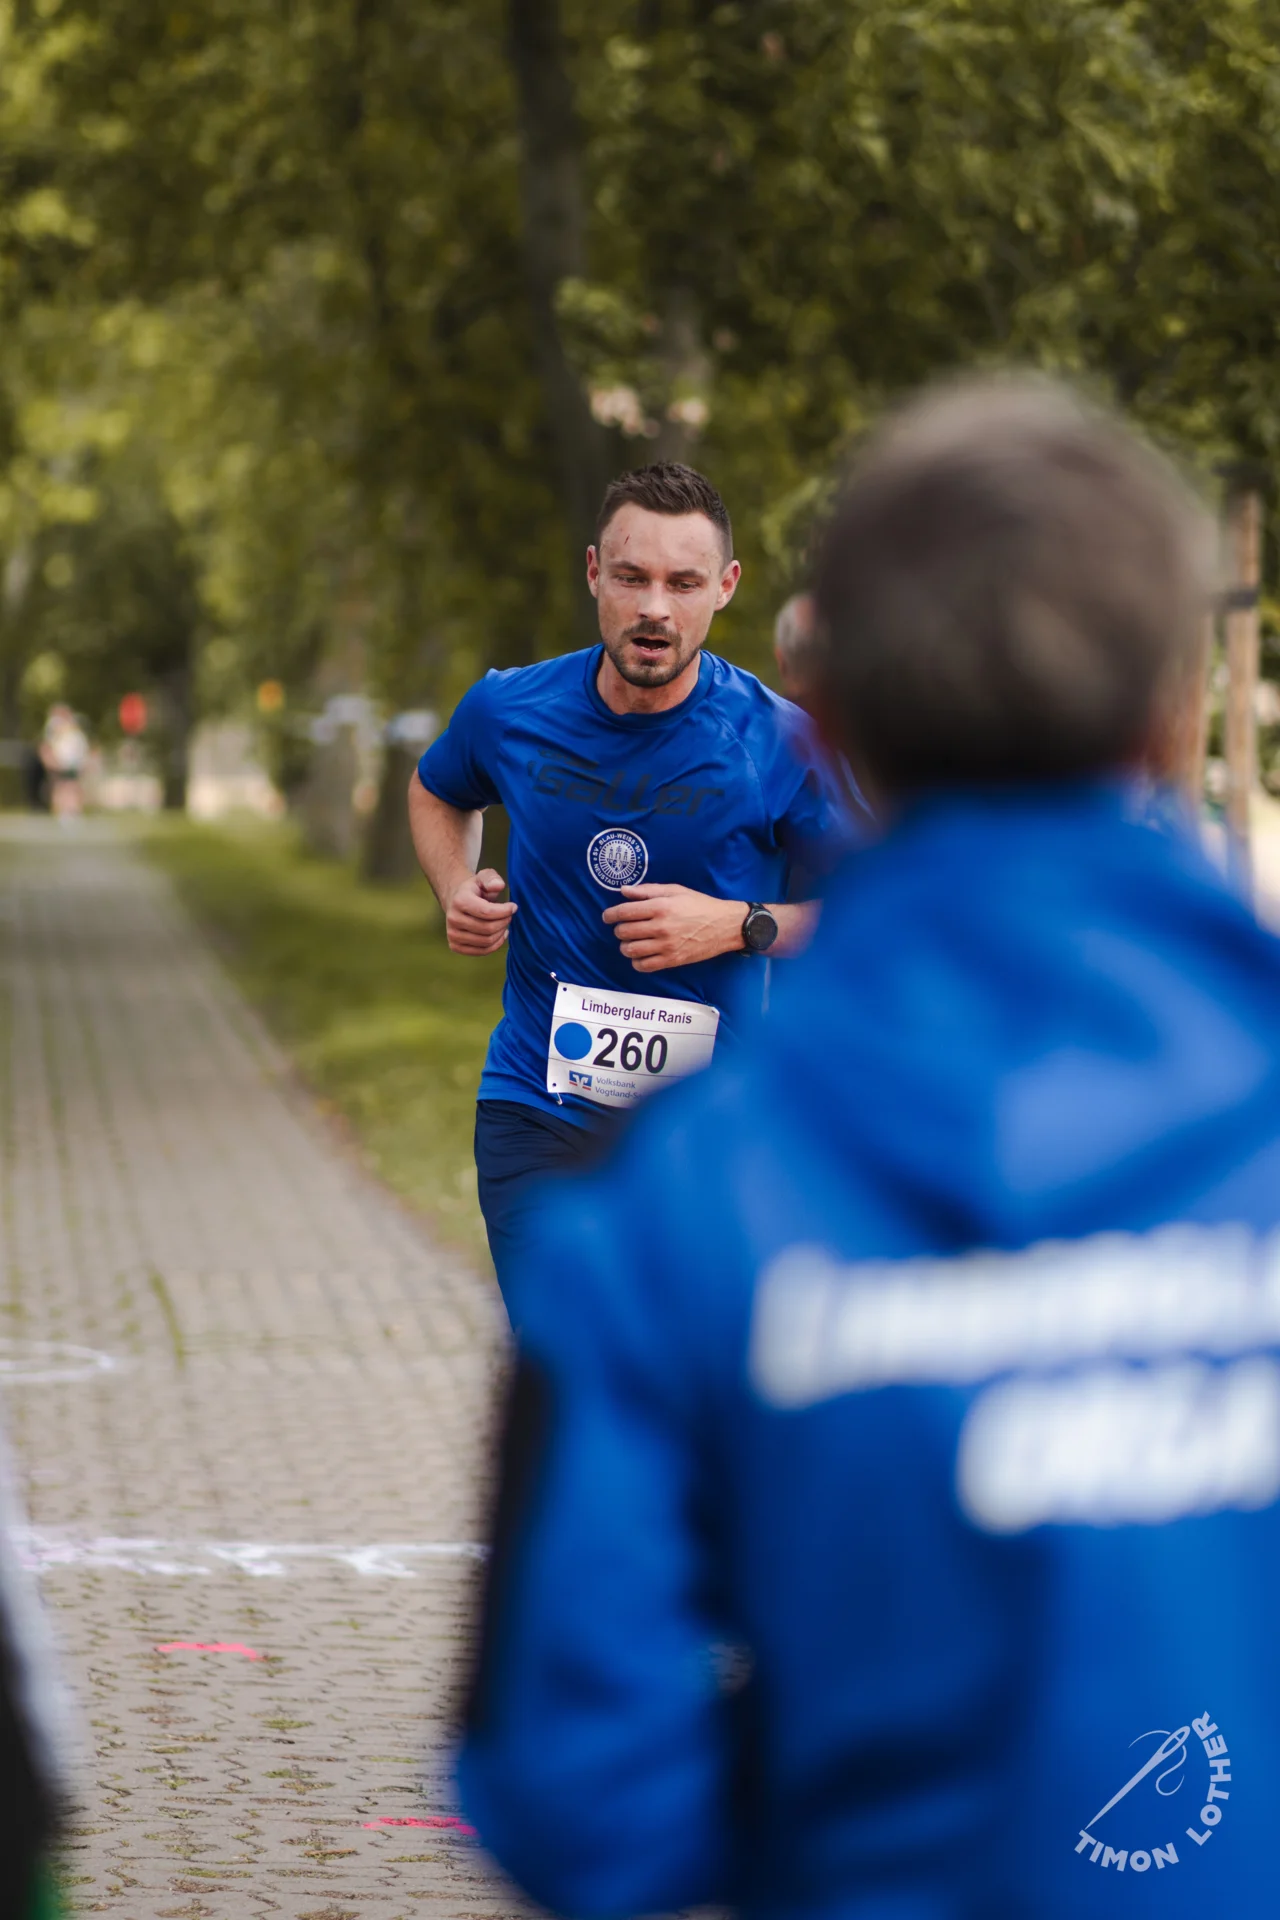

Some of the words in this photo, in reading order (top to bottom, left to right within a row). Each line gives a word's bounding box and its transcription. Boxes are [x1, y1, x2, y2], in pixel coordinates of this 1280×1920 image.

[581, 998, 656, 1022] Limberglauf
[658, 1010, 692, 1025] Ranis
[593, 1028, 668, 1074] 260
[596, 1076, 636, 1089] Volksbank
